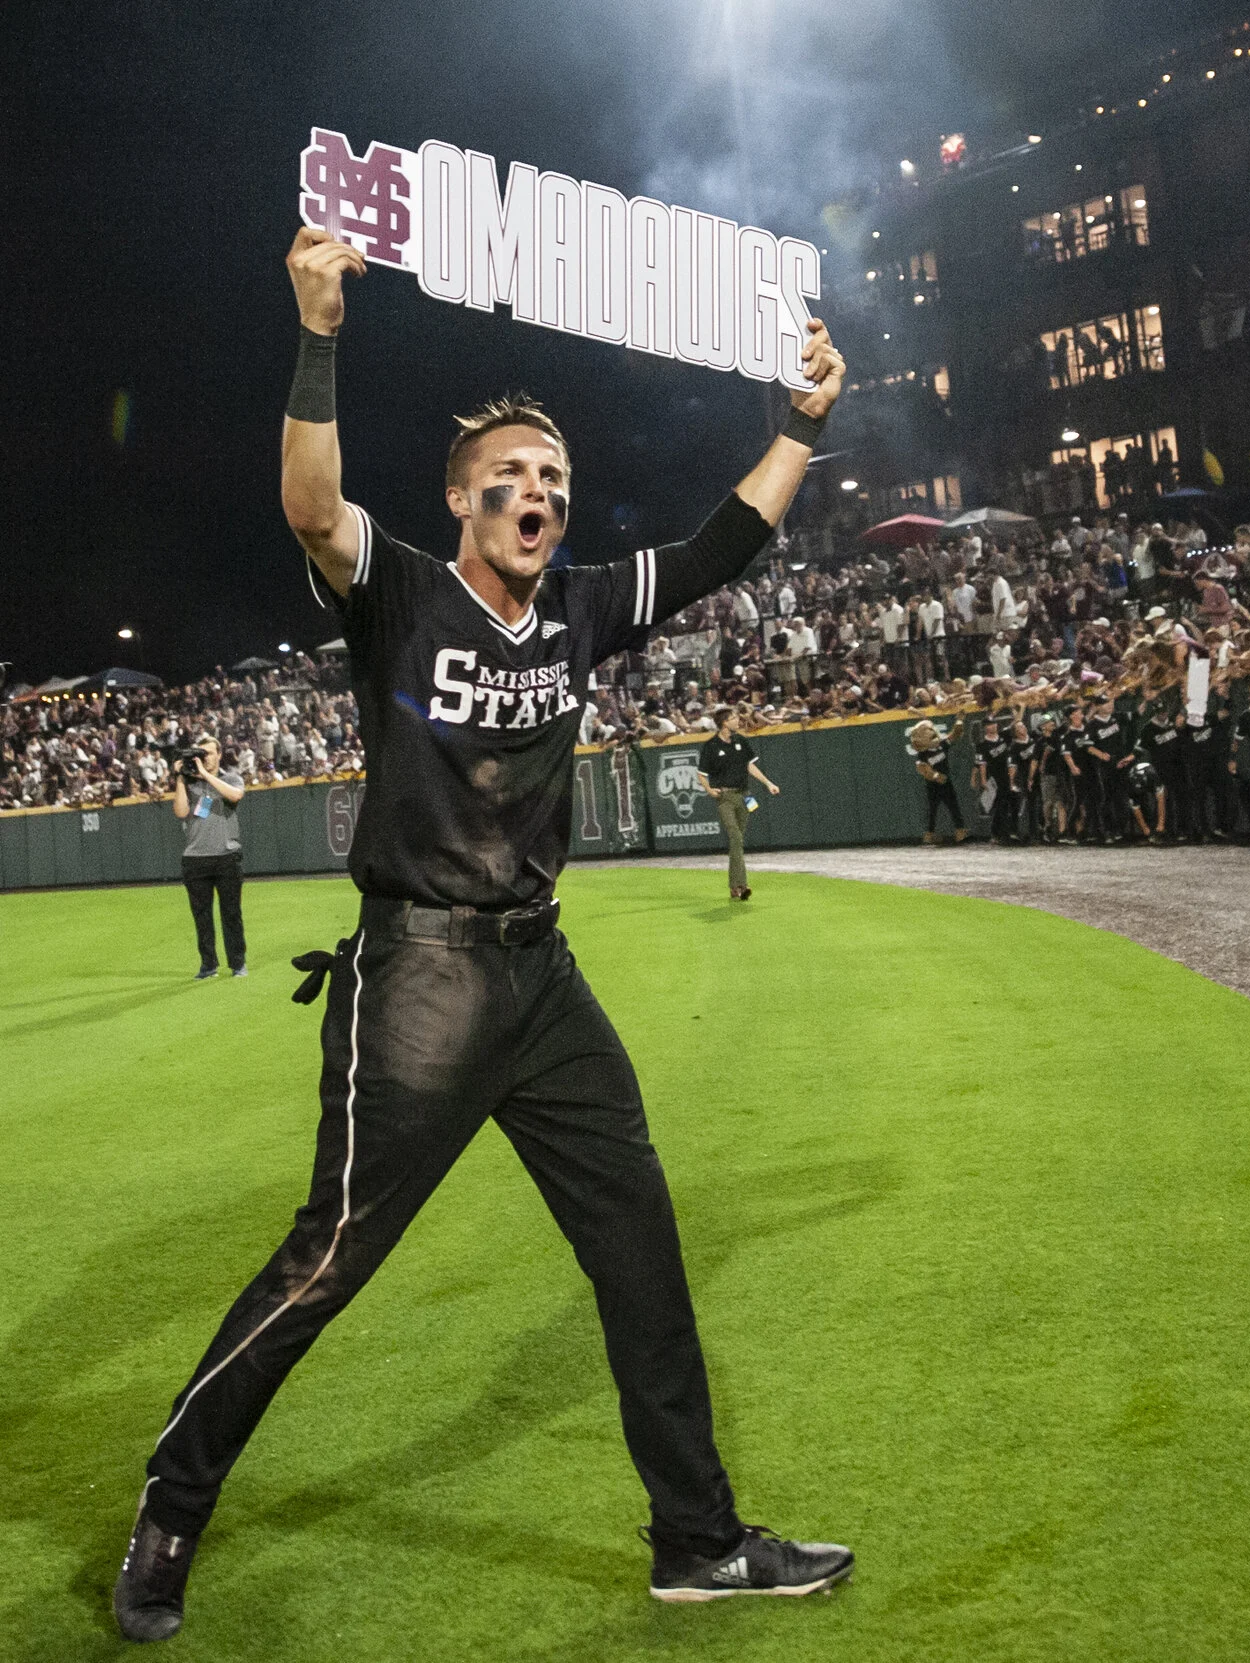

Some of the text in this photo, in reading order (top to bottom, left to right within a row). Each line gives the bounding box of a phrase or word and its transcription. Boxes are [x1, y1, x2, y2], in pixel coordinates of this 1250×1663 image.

[418, 140, 820, 390] OMADAWGS
[428, 647, 579, 729] STATE
[326, 783, 366, 856] 6
[655, 821, 721, 838] APPEARANCES
